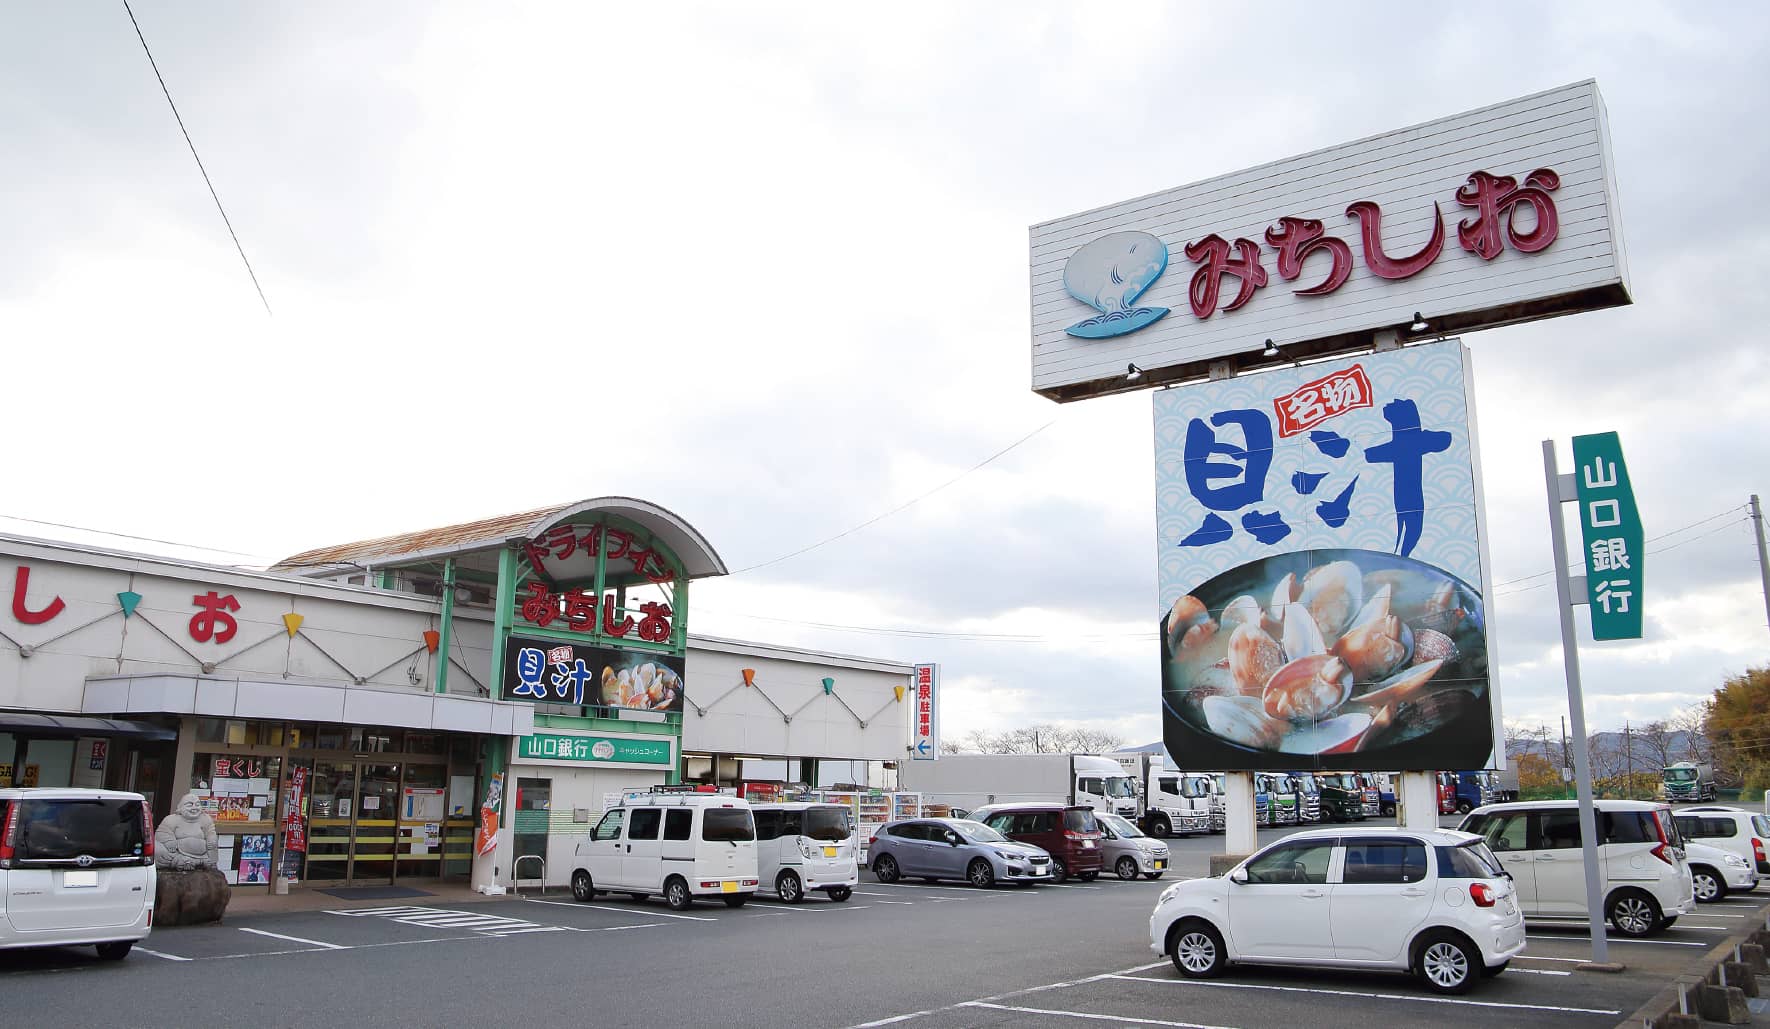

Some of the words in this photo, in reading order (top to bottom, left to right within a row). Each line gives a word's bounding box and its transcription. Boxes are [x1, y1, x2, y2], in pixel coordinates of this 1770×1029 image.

[1184, 167, 1561, 319] みちしお
[1288, 376, 1361, 422] 名物
[1177, 398, 1453, 558] 貝汁
[1583, 456, 1633, 614] 山口銀行
[522, 581, 673, 642] みちしお
[513, 648, 592, 705] 貝汁
[528, 737, 589, 758] 山口銀行
